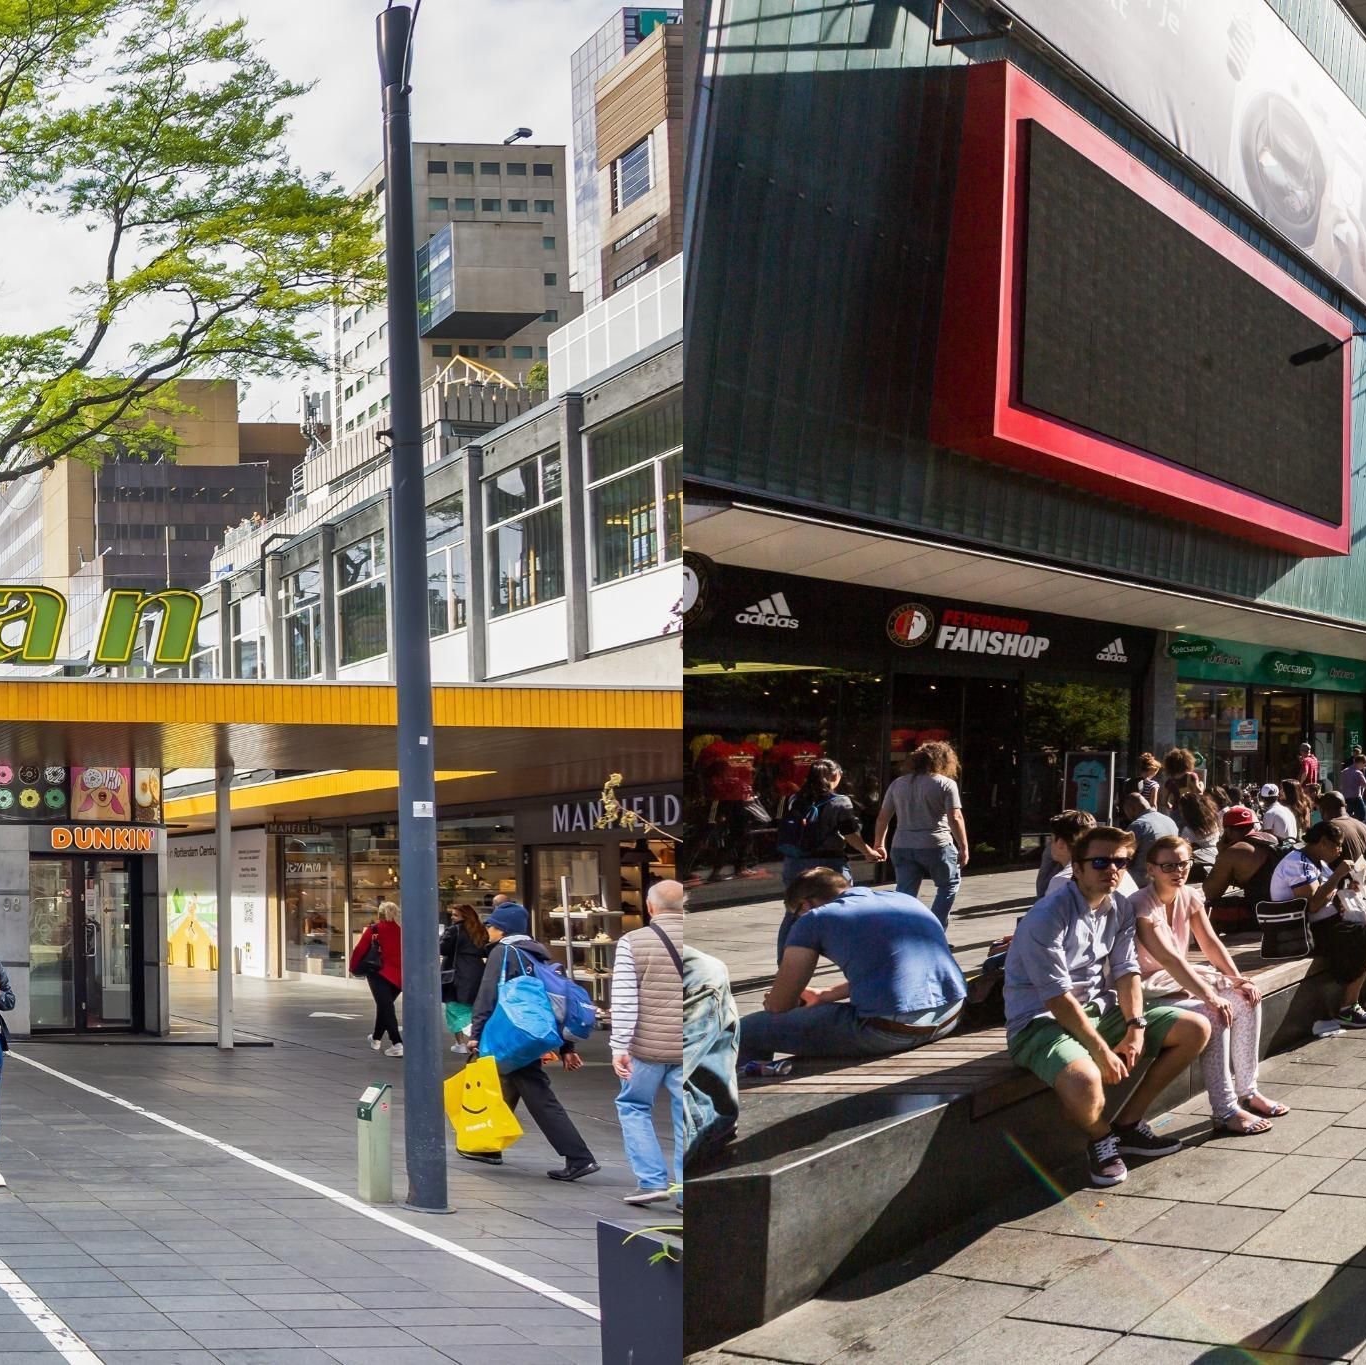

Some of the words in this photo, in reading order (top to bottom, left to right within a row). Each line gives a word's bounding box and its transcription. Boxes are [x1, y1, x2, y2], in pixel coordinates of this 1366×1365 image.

[735, 611, 799, 629] adidas
[935, 625, 1050, 658] FANSHOP
[1171, 643, 1208, 654] Specsavers
[1096, 652, 1128, 663] adidas
[1274, 660, 1313, 676] Specsavers
[269, 824, 319, 834] MANFIELD
[51, 827, 155, 850] DUNKIN'
[174, 847, 198, 858] Rotterdam
[3, 897, 22, 912] 98
